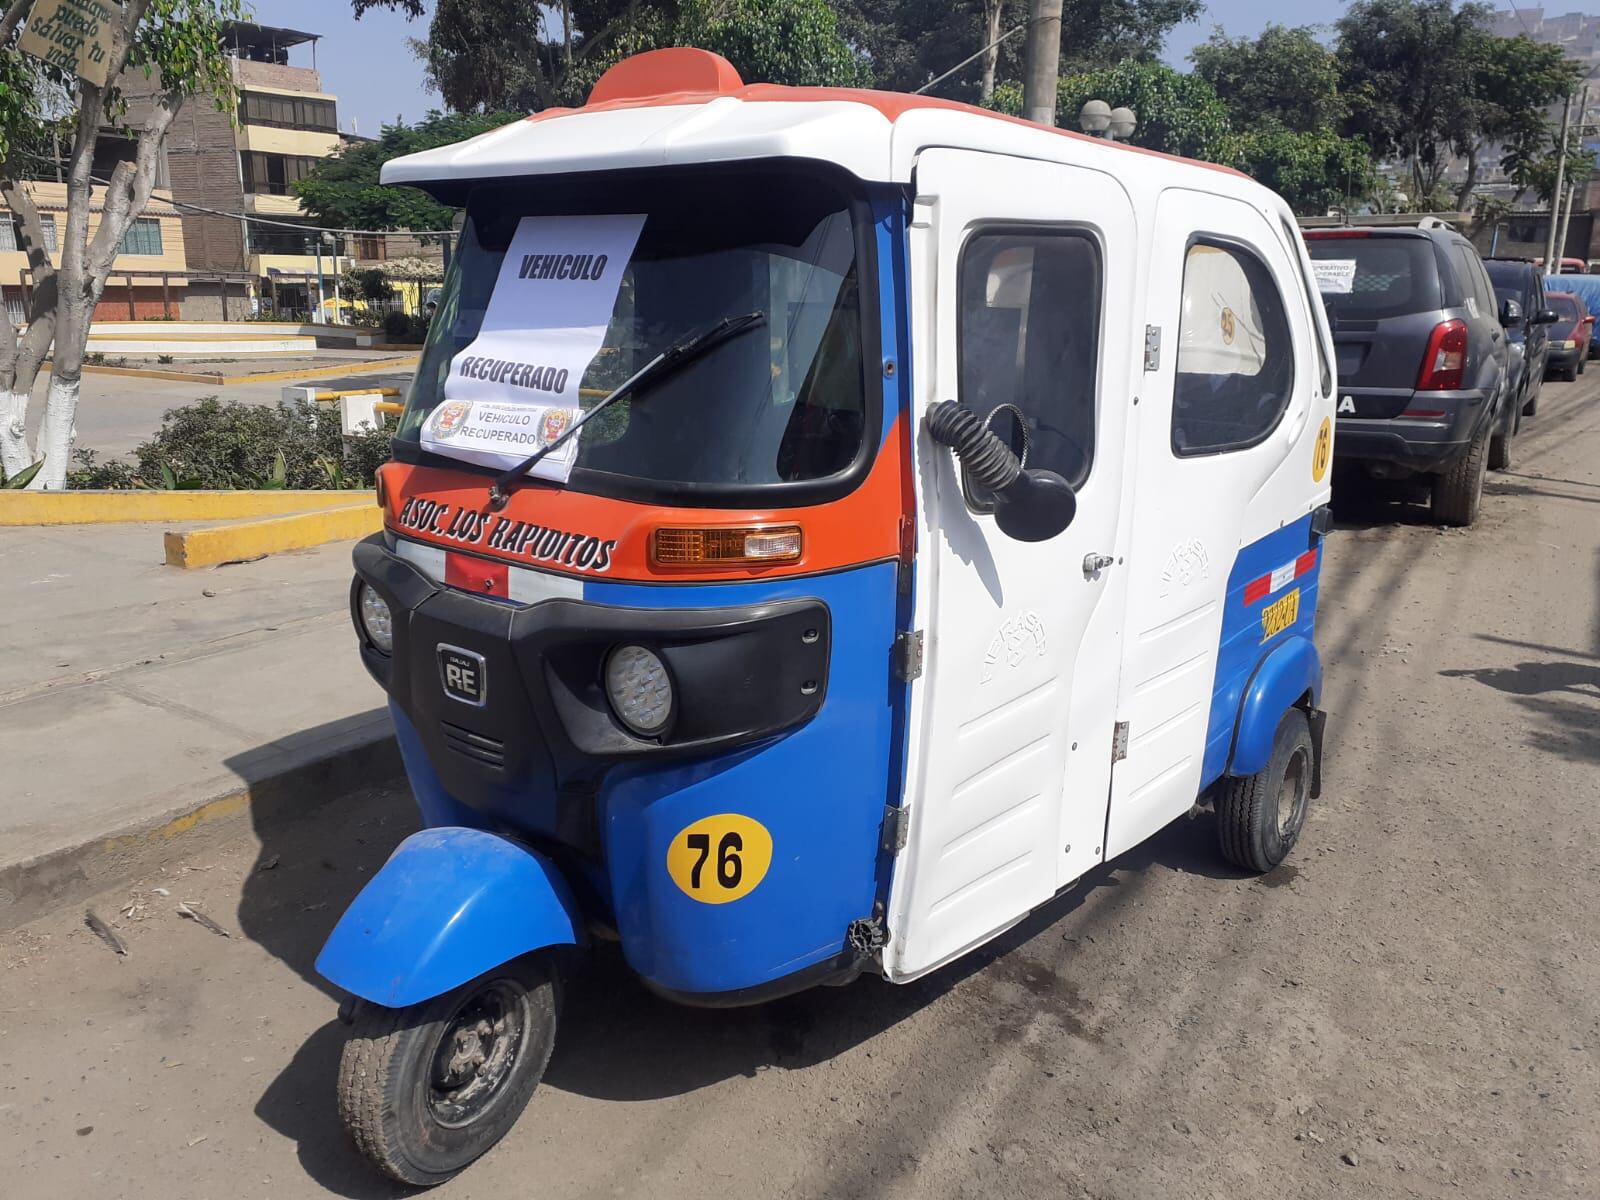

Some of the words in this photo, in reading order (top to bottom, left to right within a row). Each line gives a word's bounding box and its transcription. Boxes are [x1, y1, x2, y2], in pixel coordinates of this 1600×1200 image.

[48, 4, 98, 37] puedo
[31, 17, 85, 50] salvar
[88, 41, 105, 64] tu
[45, 46, 79, 73] vida
[518, 254, 608, 281] VEHICULO
[459, 356, 569, 394] RECUPERADO
[479, 411, 531, 426] VEHICULO
[460, 427, 536, 445] RECUPERADO
[446, 506, 491, 543] LOS
[487, 516, 618, 572] RAPIDITOS
[446, 663, 478, 695] RE
[687, 831, 743, 889] 76
